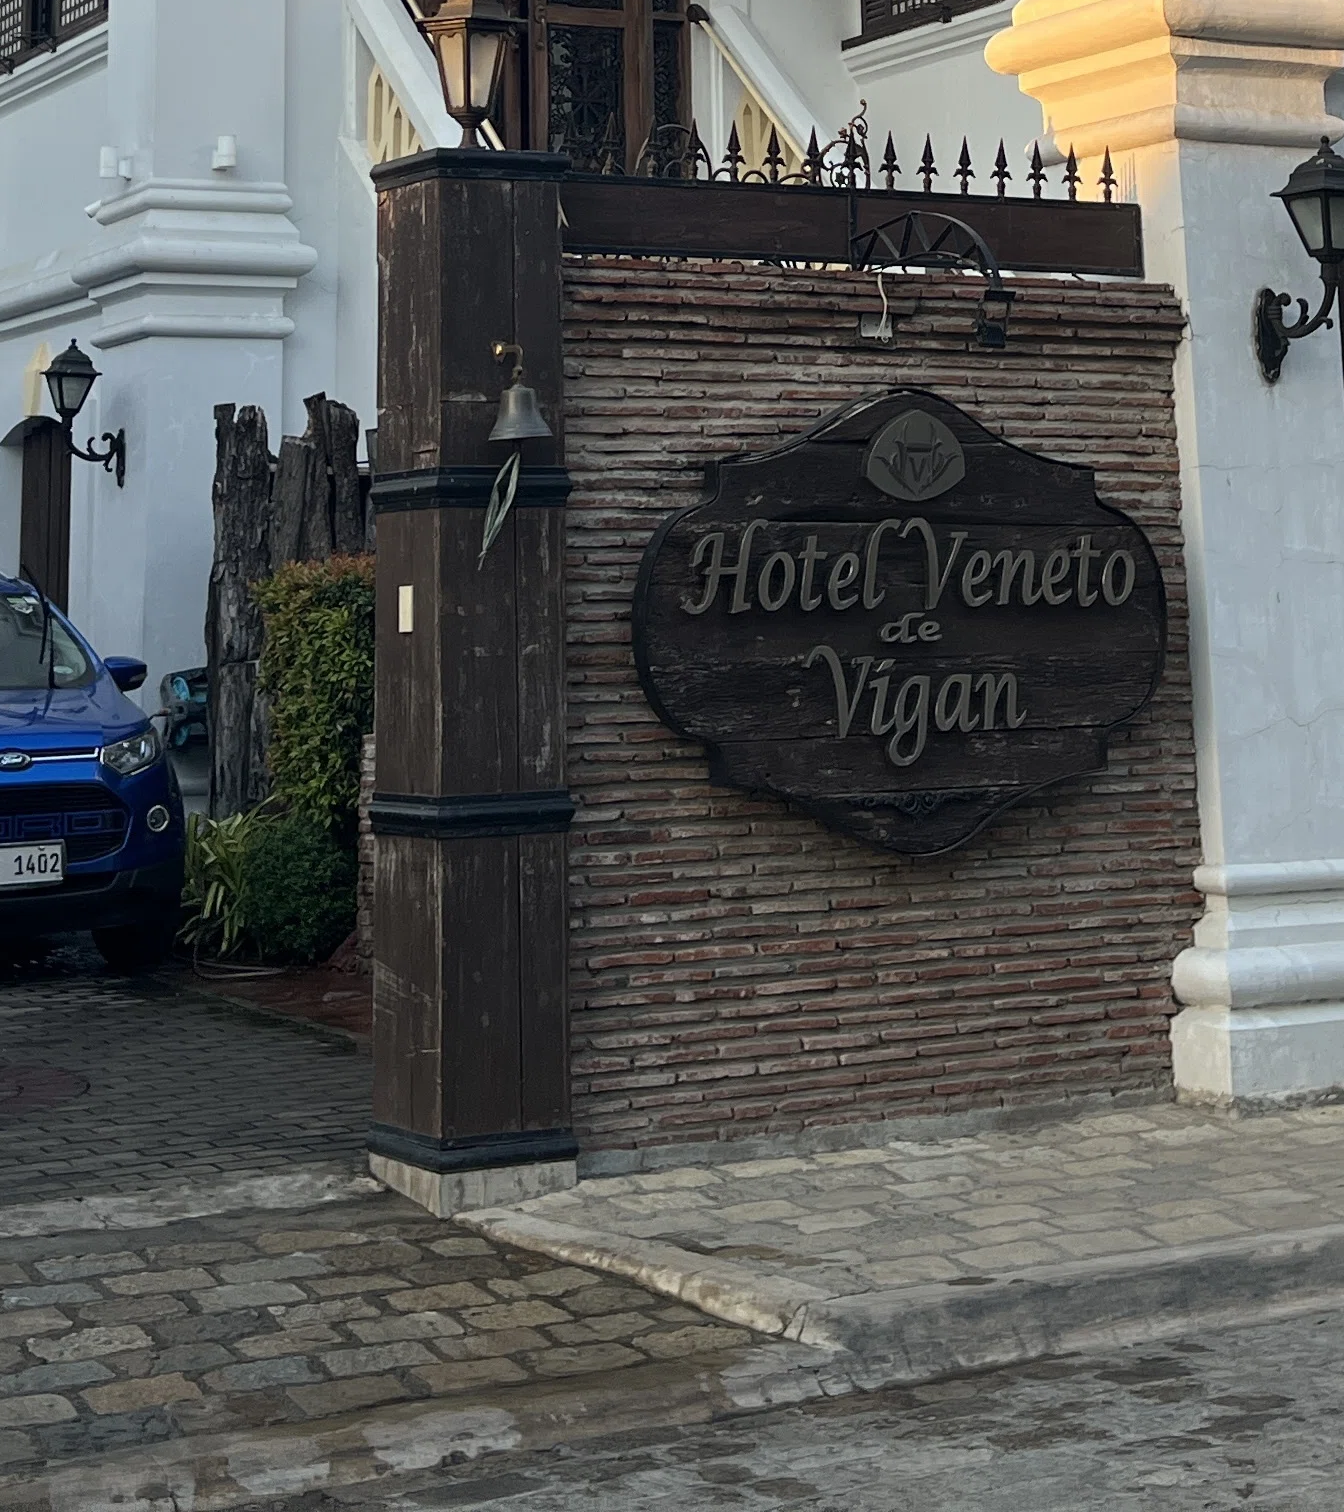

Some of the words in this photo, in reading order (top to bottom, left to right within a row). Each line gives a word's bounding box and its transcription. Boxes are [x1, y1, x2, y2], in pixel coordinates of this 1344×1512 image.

[681, 518, 900, 615] Hotel
[896, 517, 1137, 610] Veneto
[878, 612, 943, 644] de
[803, 645, 1027, 767] Vigan
[13, 852, 60, 876] 1402
